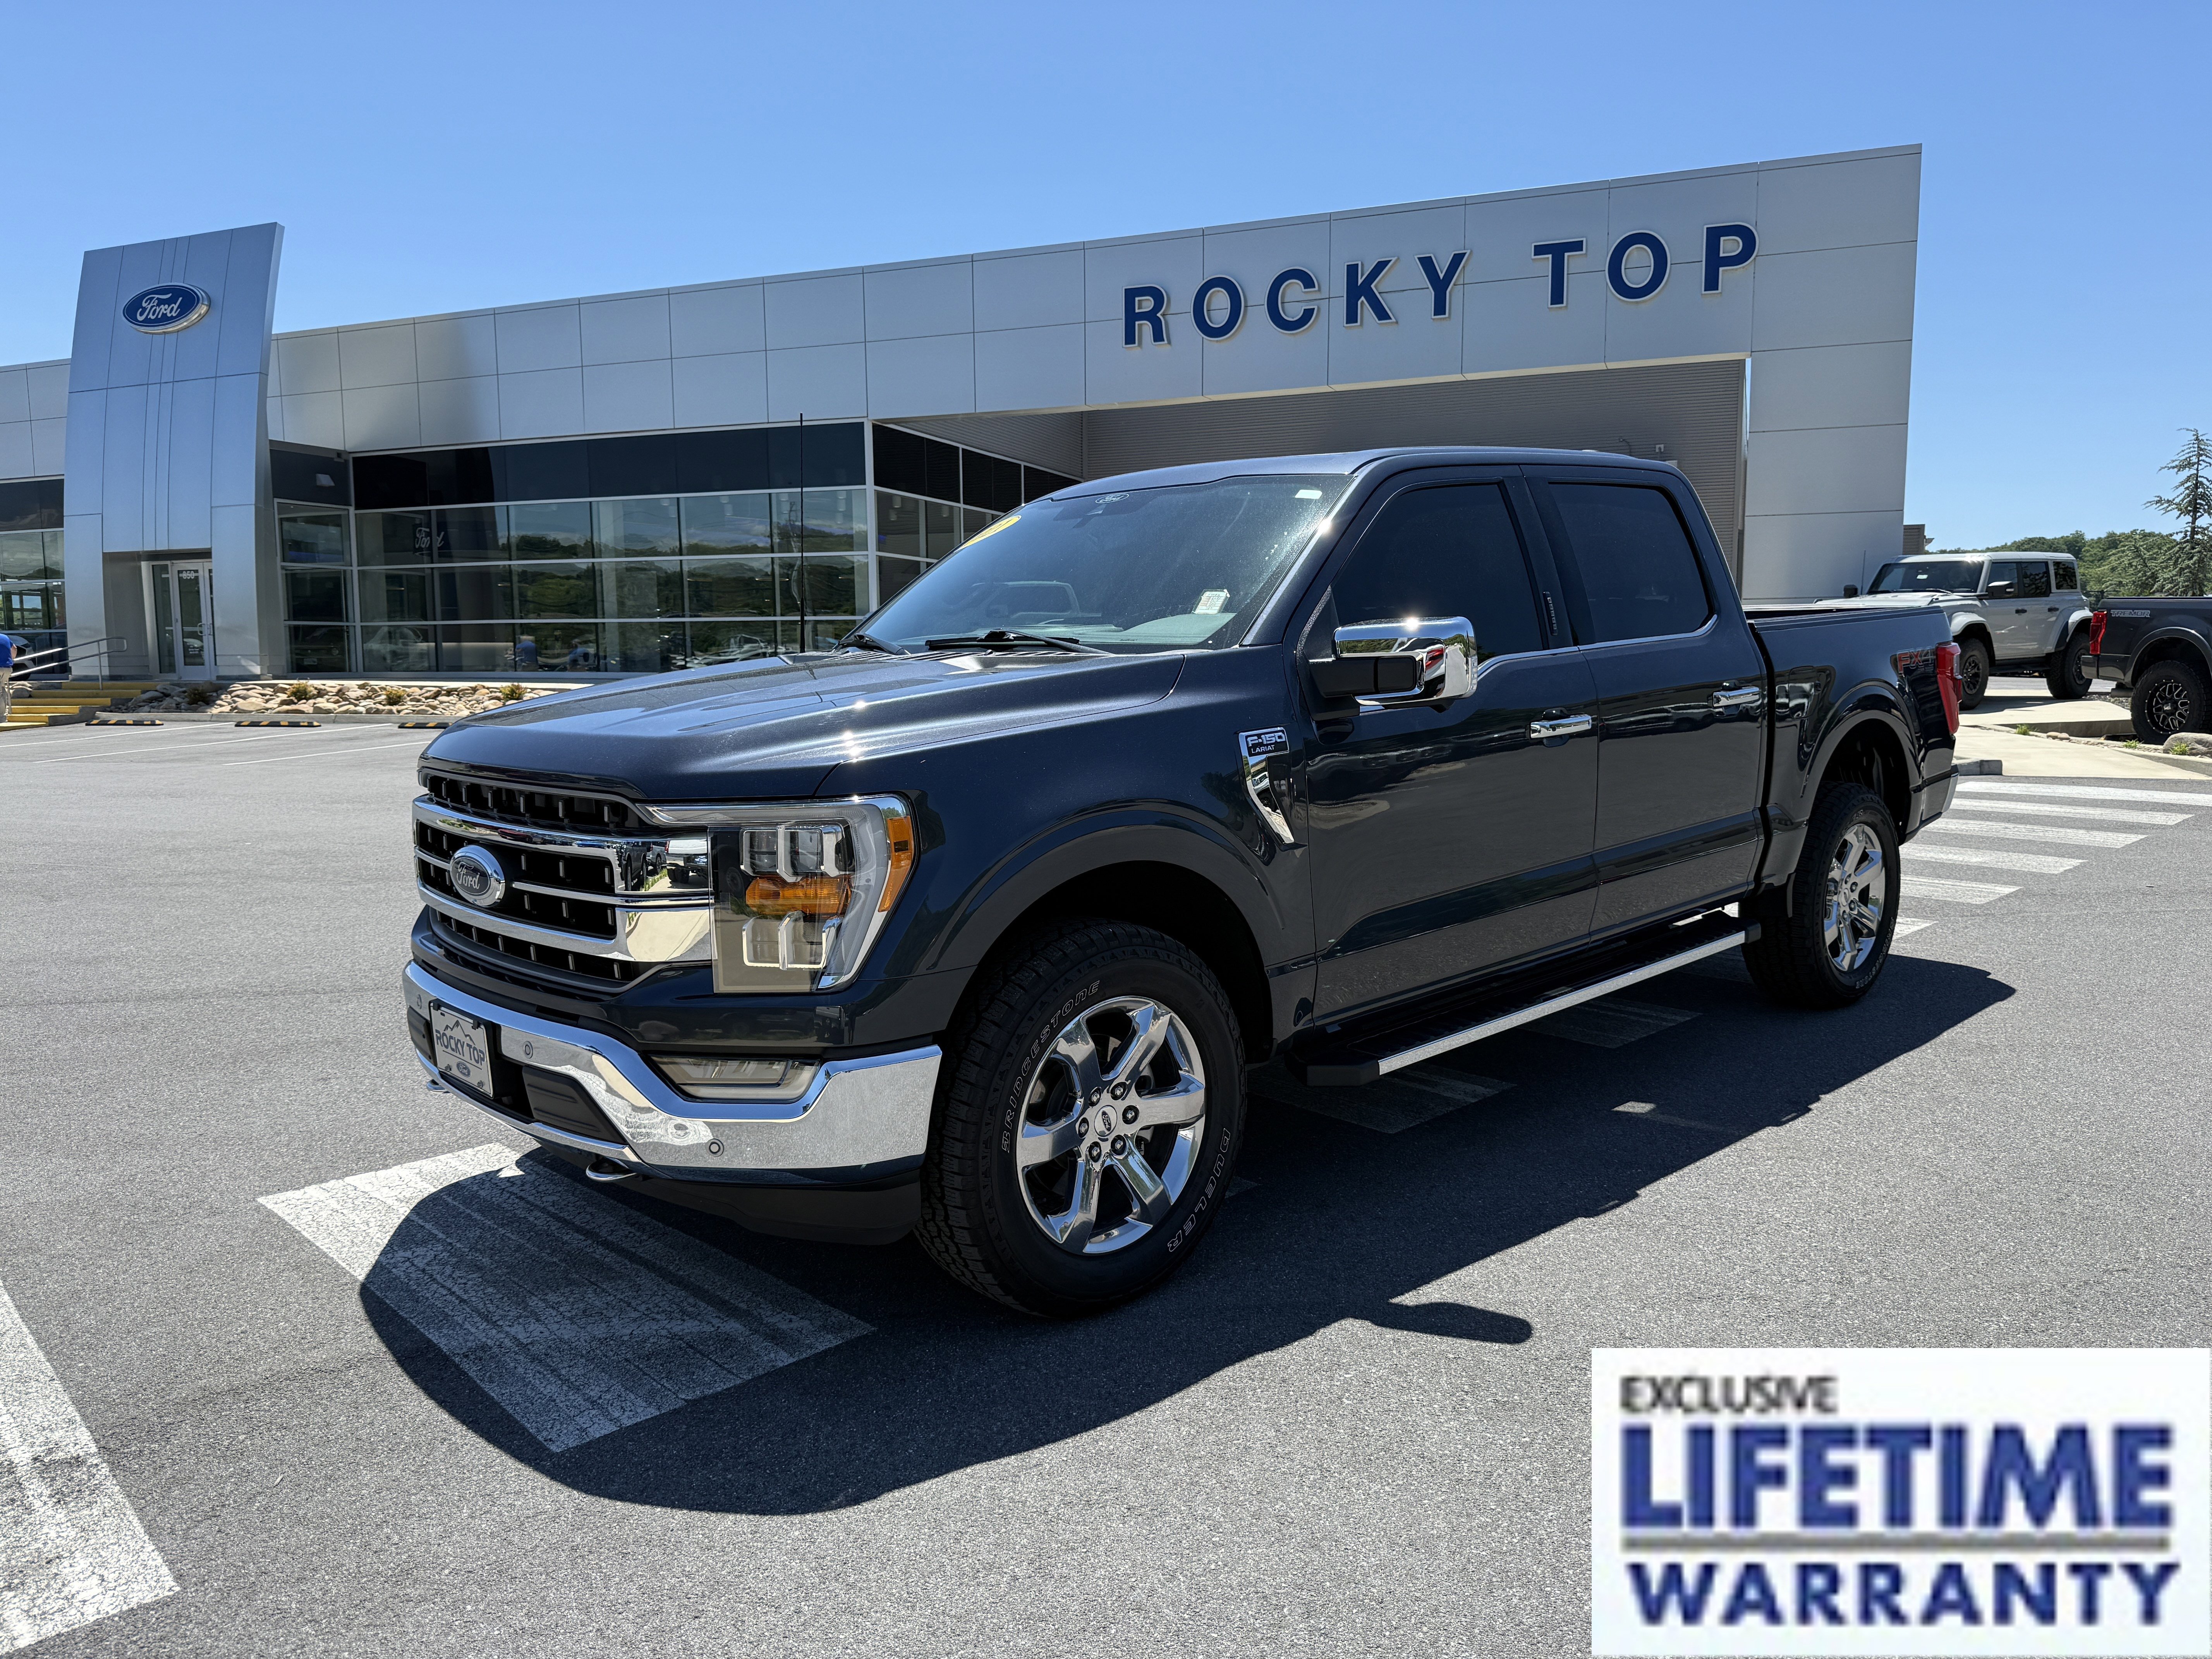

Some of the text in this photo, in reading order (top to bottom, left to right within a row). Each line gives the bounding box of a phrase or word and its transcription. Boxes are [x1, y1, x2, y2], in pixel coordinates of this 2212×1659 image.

[1123, 222, 1759, 349] ROCKY TOP
[137, 293, 182, 321] Ford
[183, 571, 194, 579] 850
[1897, 646, 1936, 675] FX4
[1247, 732, 1286, 747] F-150
[1252, 745, 1274, 753] LARIAT
[457, 862, 480, 889] Ford
[435, 1029, 485, 1066] ROCKY TOP
[1002, 981, 1100, 1153] BRIDGESTONE
[1103, 1115, 1111, 1128] Ford
[1168, 1128, 1230, 1252] DUELER
